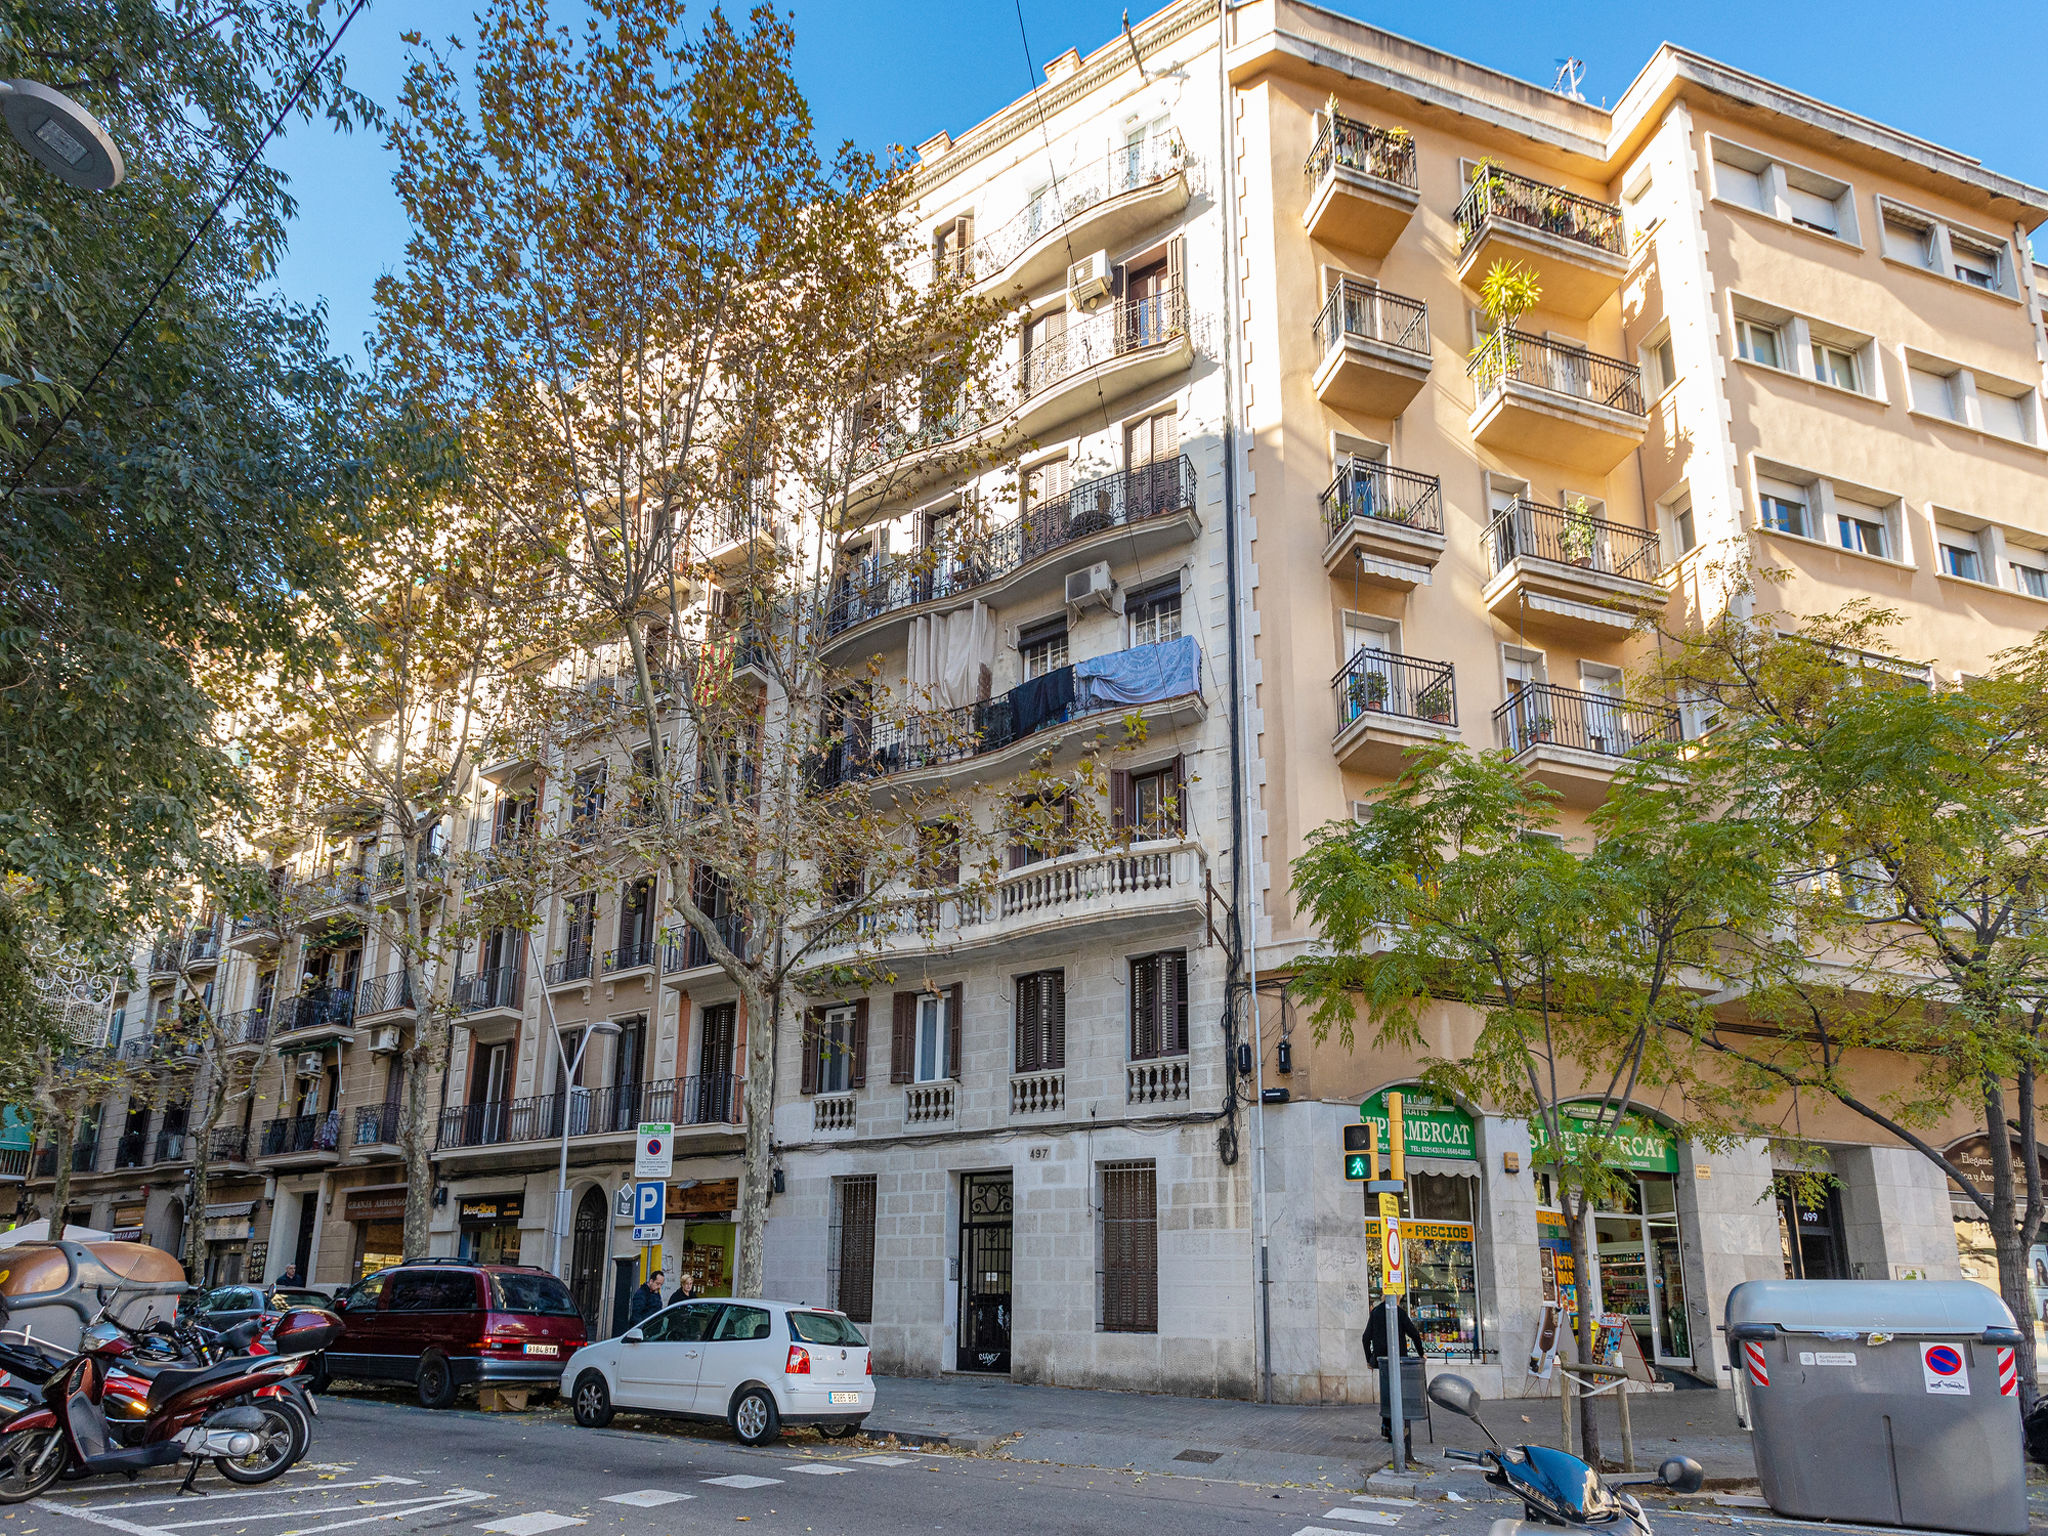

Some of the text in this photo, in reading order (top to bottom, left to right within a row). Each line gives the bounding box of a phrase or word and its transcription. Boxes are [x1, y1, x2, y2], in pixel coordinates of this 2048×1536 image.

[1030, 1149, 1049, 1159] 497
[640, 1186, 658, 1221] P
[1802, 1212, 1819, 1222] 499
[1415, 1224, 1469, 1239] PRECIOS
